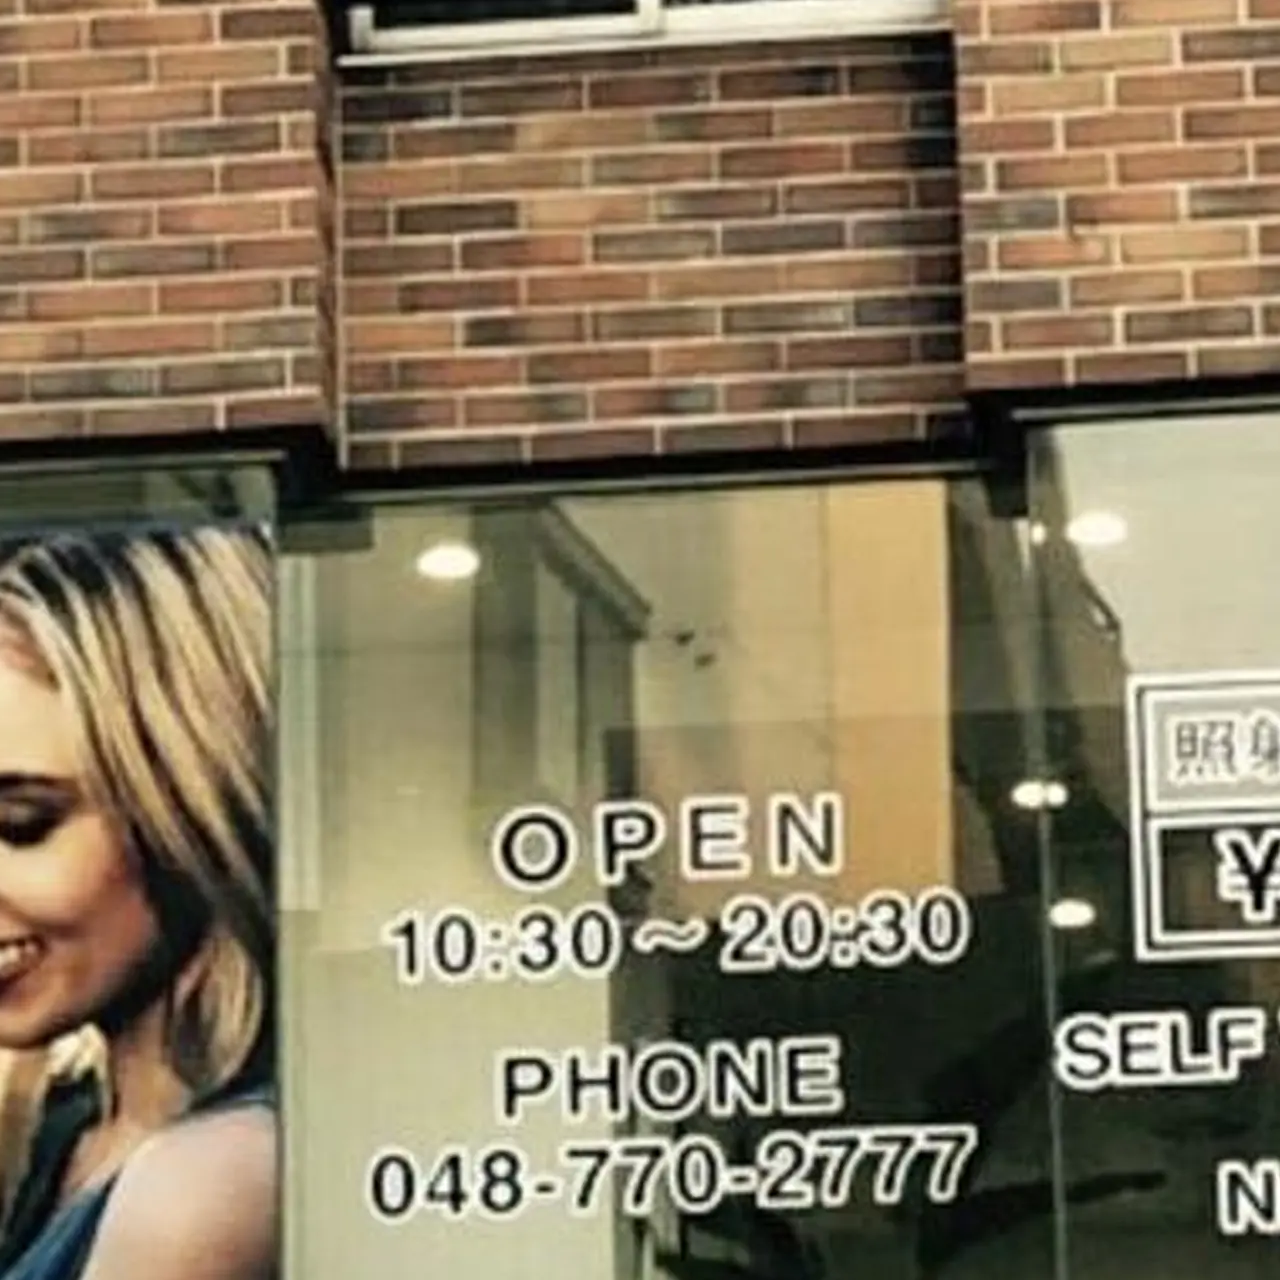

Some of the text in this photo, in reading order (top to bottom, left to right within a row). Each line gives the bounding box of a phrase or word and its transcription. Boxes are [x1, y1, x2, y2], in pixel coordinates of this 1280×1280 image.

[494, 791, 846, 891] OPEN
[496, 1034, 846, 1126] PHONE
[1054, 1006, 1265, 1089] SELF
[365, 1123, 977, 1220] 048-770-2777
